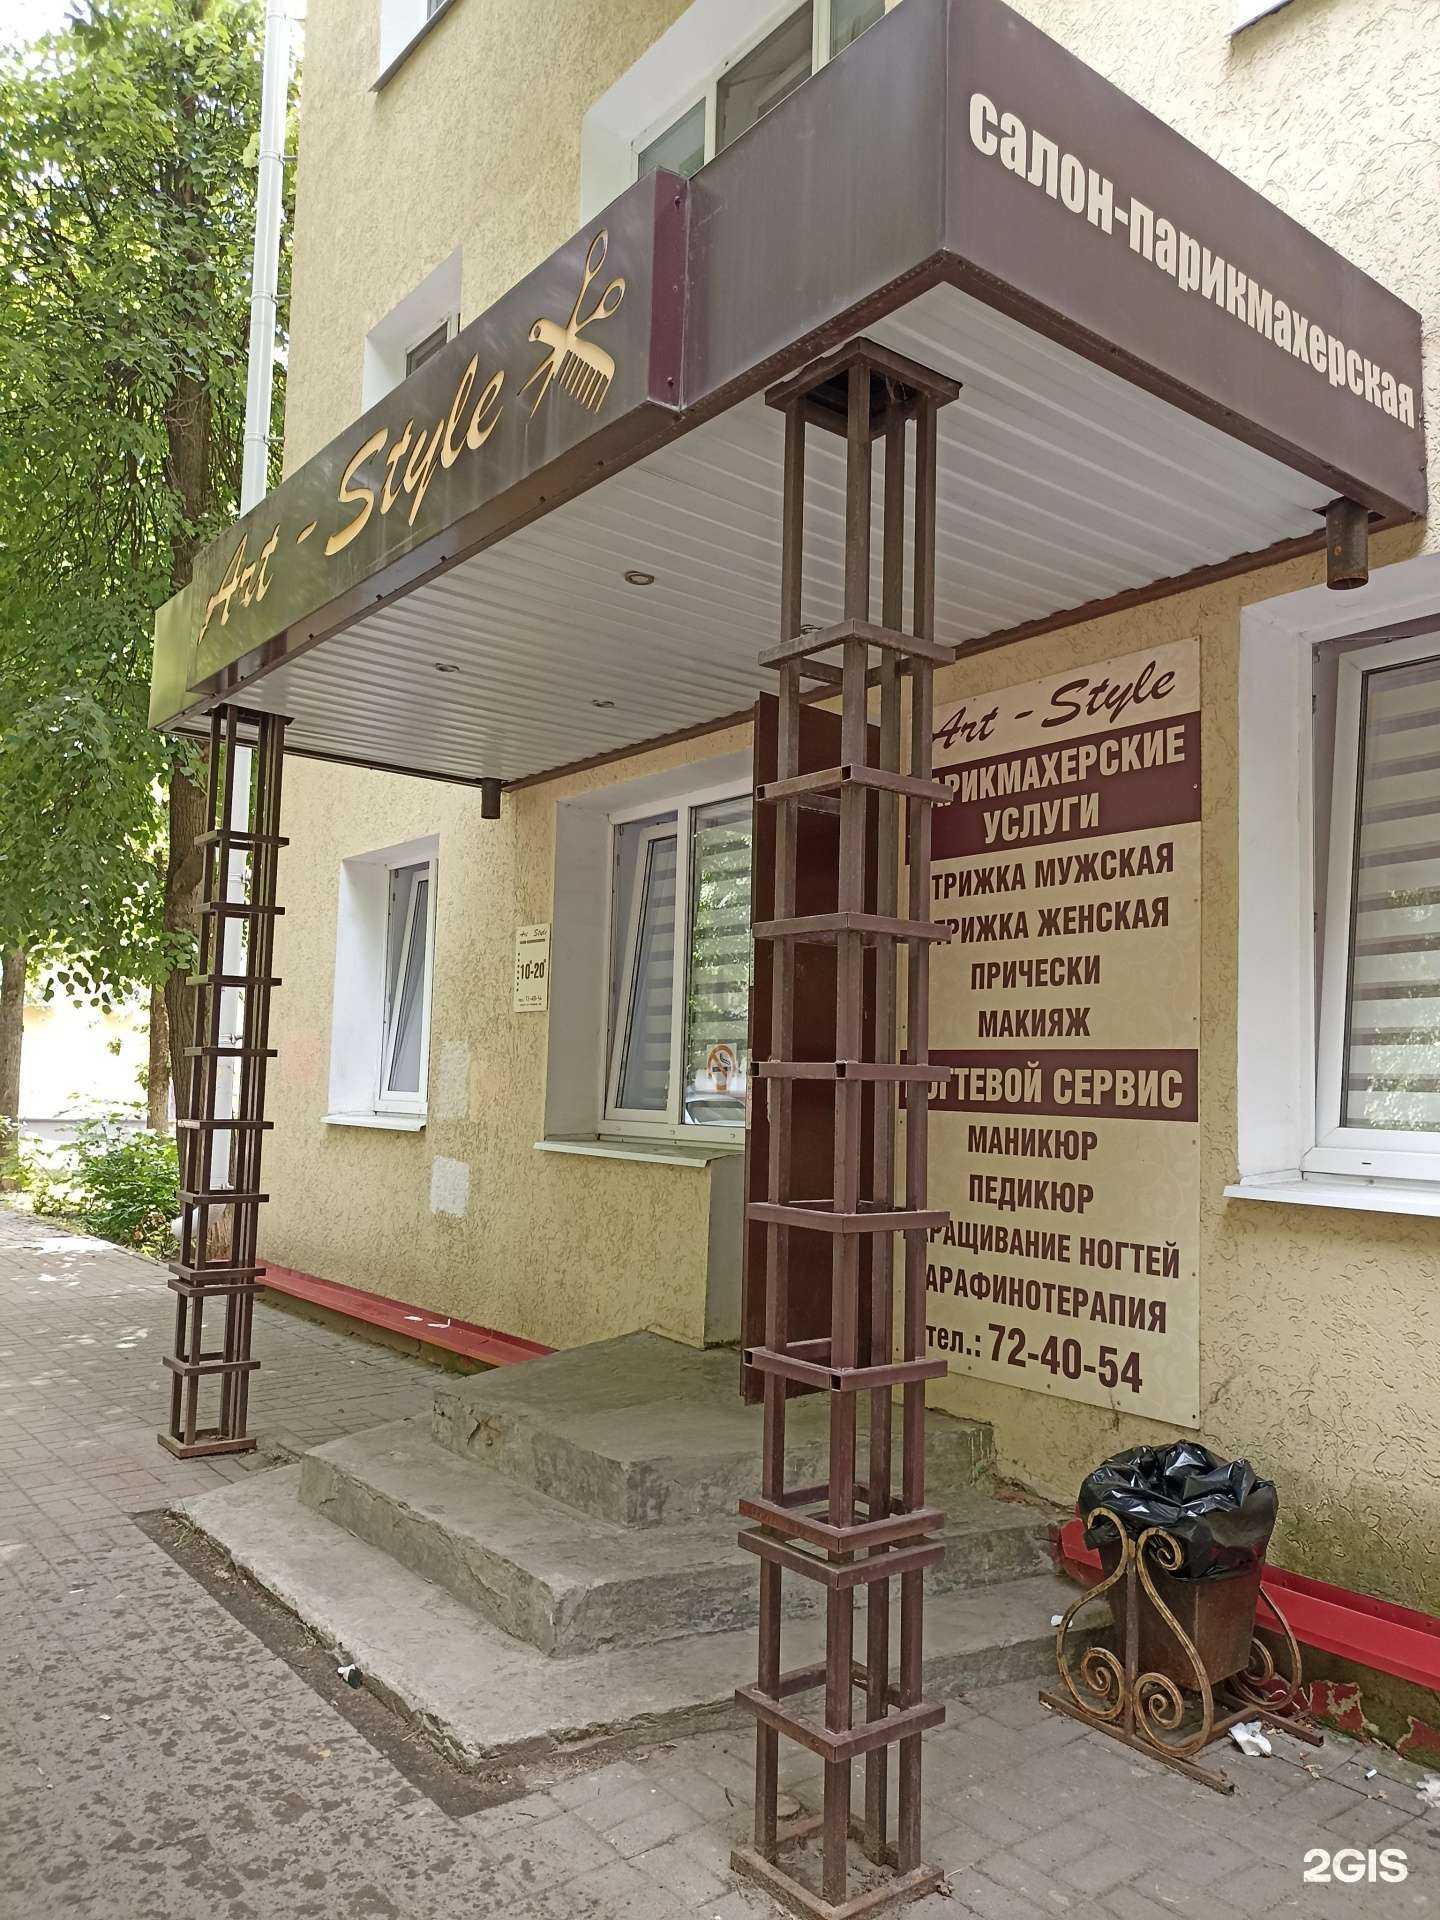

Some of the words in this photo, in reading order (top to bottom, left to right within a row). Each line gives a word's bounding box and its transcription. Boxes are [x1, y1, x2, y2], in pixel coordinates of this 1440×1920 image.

[969, 92, 1415, 429] салон-парикмахерская
[197, 522, 280, 645] Art
[323, 352, 506, 557] Style
[932, 706, 999, 750] Art
[1041, 660, 1177, 729] Style
[983, 792, 1100, 845] УСЛУГИ
[932, 862, 1026, 901] ТРИЖКА
[1034, 841, 1174, 889] МУЖСКАЯ
[1037, 896, 1170, 938] ЖЕНСКАЯ
[970, 955, 1101, 991] ПРИЧЕСКИ
[978, 1007, 1091, 1039] МАКИЯЖ
[1053, 1068, 1183, 1109] СЕРВИС
[967, 1125, 1098, 1161] МАНИКЮР
[969, 1174, 1094, 1214] ПЕДИКЮР
[1079, 1240, 1180, 1279] НОГТЕЙ
[926, 1263, 1167, 1334] АРАФИНОТЕРАПИЯ
[988, 1323, 1143, 1394] 72-40-54
